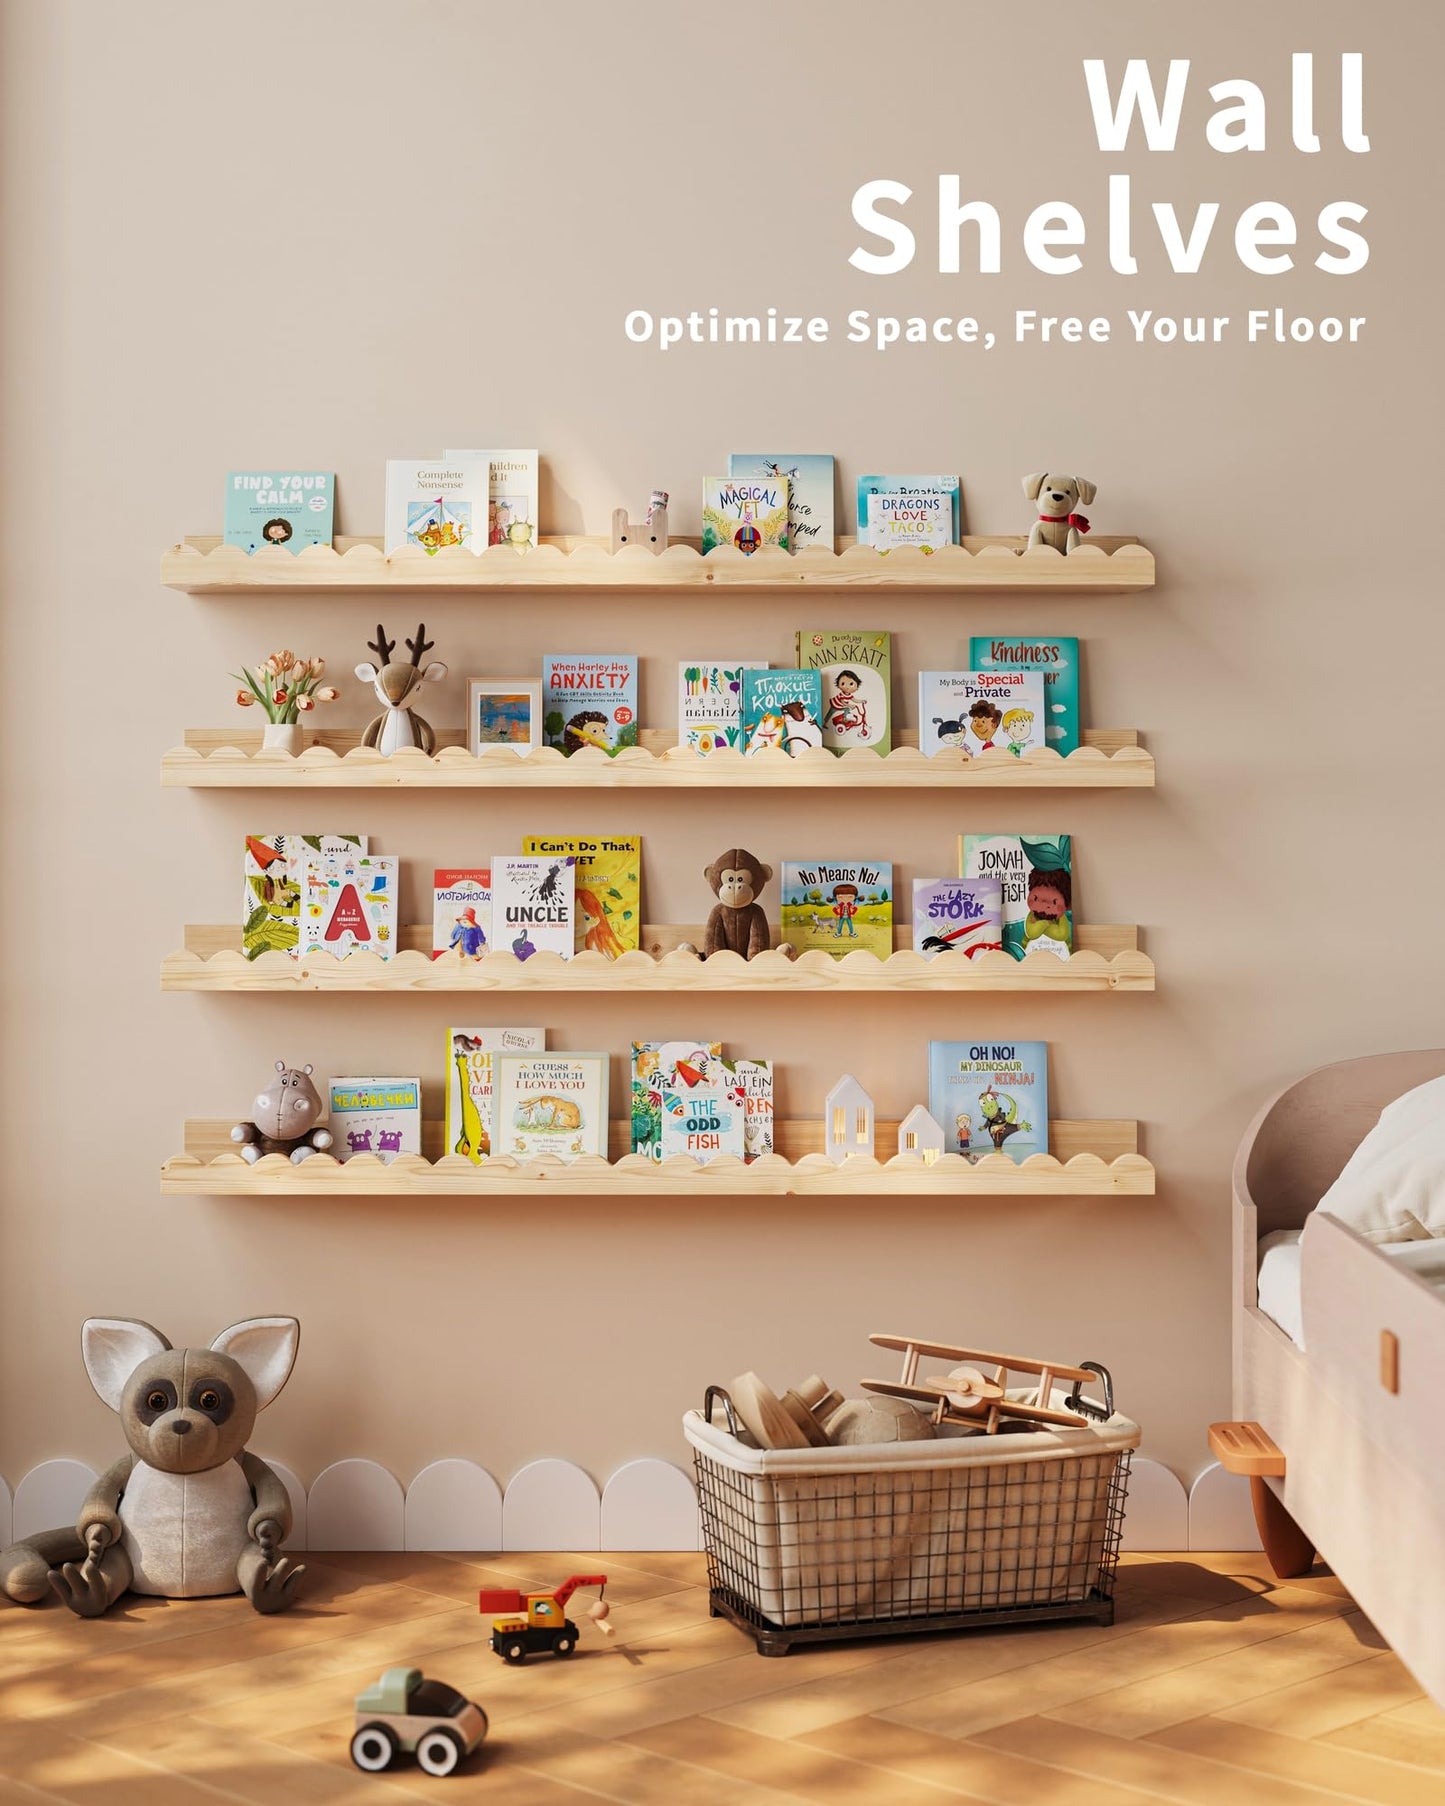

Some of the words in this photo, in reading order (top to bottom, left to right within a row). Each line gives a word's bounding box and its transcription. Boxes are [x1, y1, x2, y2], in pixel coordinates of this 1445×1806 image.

[489, 462, 528, 471] hildren
[233, 476, 273, 490] FIND
[280, 475, 326, 490] YOUR
[417, 470, 464, 481] Complete
[417, 480, 464, 489] Nonsense
[255, 490, 304, 505] CALM
[720, 487, 776, 509] MAGICAL
[882, 499, 940, 510] DRAGONS
[735, 501, 760, 519] YET
[894, 510, 928, 521] LOVE
[788, 521, 821, 538] mped
[888, 521, 934, 533] TACOS
[808, 646, 837, 670] MIN
[841, 644, 887, 668] SKATT
[991, 641, 1060, 663] Kindness
[551, 663, 576, 671] When
[578, 662, 610, 672] Harley
[611, 662, 629, 672] Has
[550, 672, 630, 689] ANXIETY
[939, 679, 950, 687] My
[951, 679, 969, 687] Body
[977, 673, 1025, 688] Special
[965, 686, 1011, 698] Private
[531, 842, 536, 851] I
[578, 842, 597, 851] Do
[601, 842, 635, 852] That,
[978, 848, 1023, 870] JONAH
[798, 870, 816, 886] No
[818, 866, 856, 884] Means
[858, 867, 880, 886] No!
[1009, 871, 1026, 883] very
[932, 894, 947, 902] THE
[948, 889, 975, 902] LAZY
[506, 906, 569, 922] UNCLE
[928, 900, 985, 920] STORK
[970, 1046, 988, 1060] OH
[992, 1046, 1015, 1060] NO!
[533, 1063, 569, 1071] GUESS
[960, 1061, 973, 1072] MY
[975, 1061, 1022, 1072] DINOSAUR
[549, 1072, 583, 1080] MUCH
[516, 1080, 520, 1088] I
[525, 1080, 557, 1089] LOVE
[560, 1081, 585, 1090] YOU
[688, 1099, 717, 1116] THE
[686, 1117, 721, 1131] ODD
[687, 1134, 720, 1150] FISH
